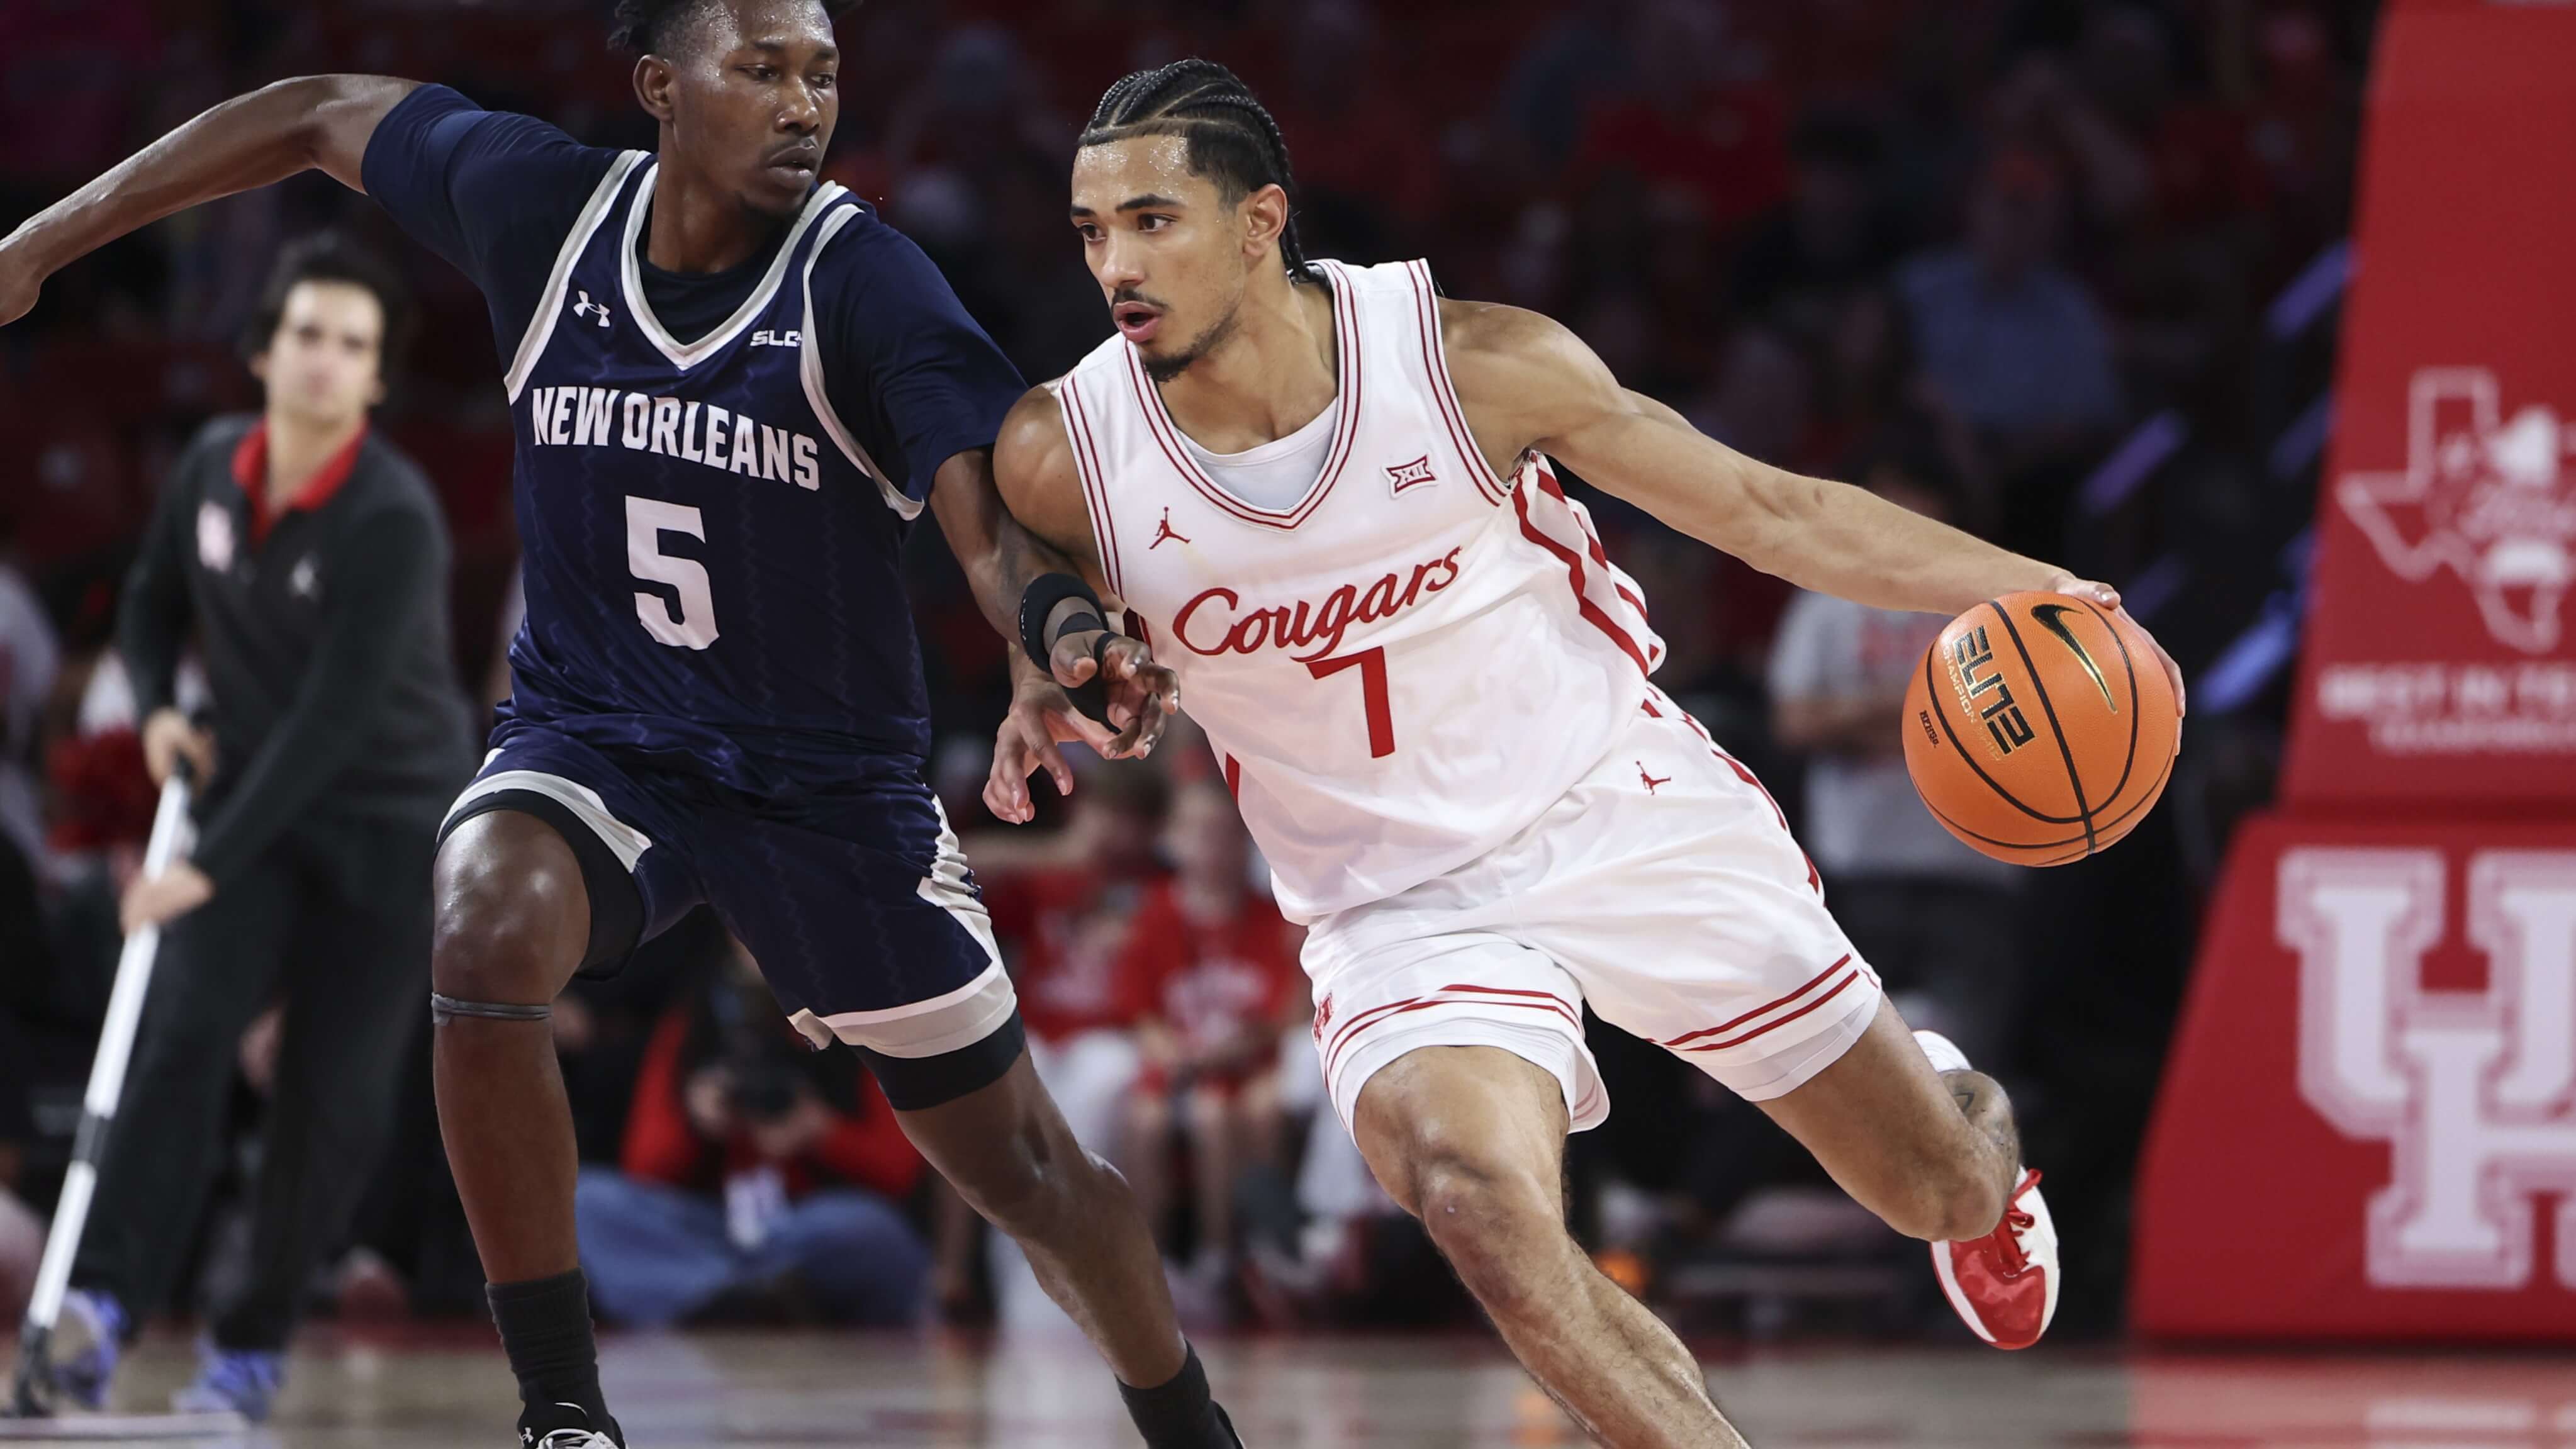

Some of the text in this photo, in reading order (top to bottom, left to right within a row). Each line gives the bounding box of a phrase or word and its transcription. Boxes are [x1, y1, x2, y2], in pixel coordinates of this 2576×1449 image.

[532, 386, 820, 491] NEW ORLEANS
[625, 495, 720, 651] 5
[1172, 545, 1463, 663] Cougars
[1306, 646, 1395, 759] 7
[1952, 625, 2036, 755] ELITE
[2458, 667, 2507, 717] IN
